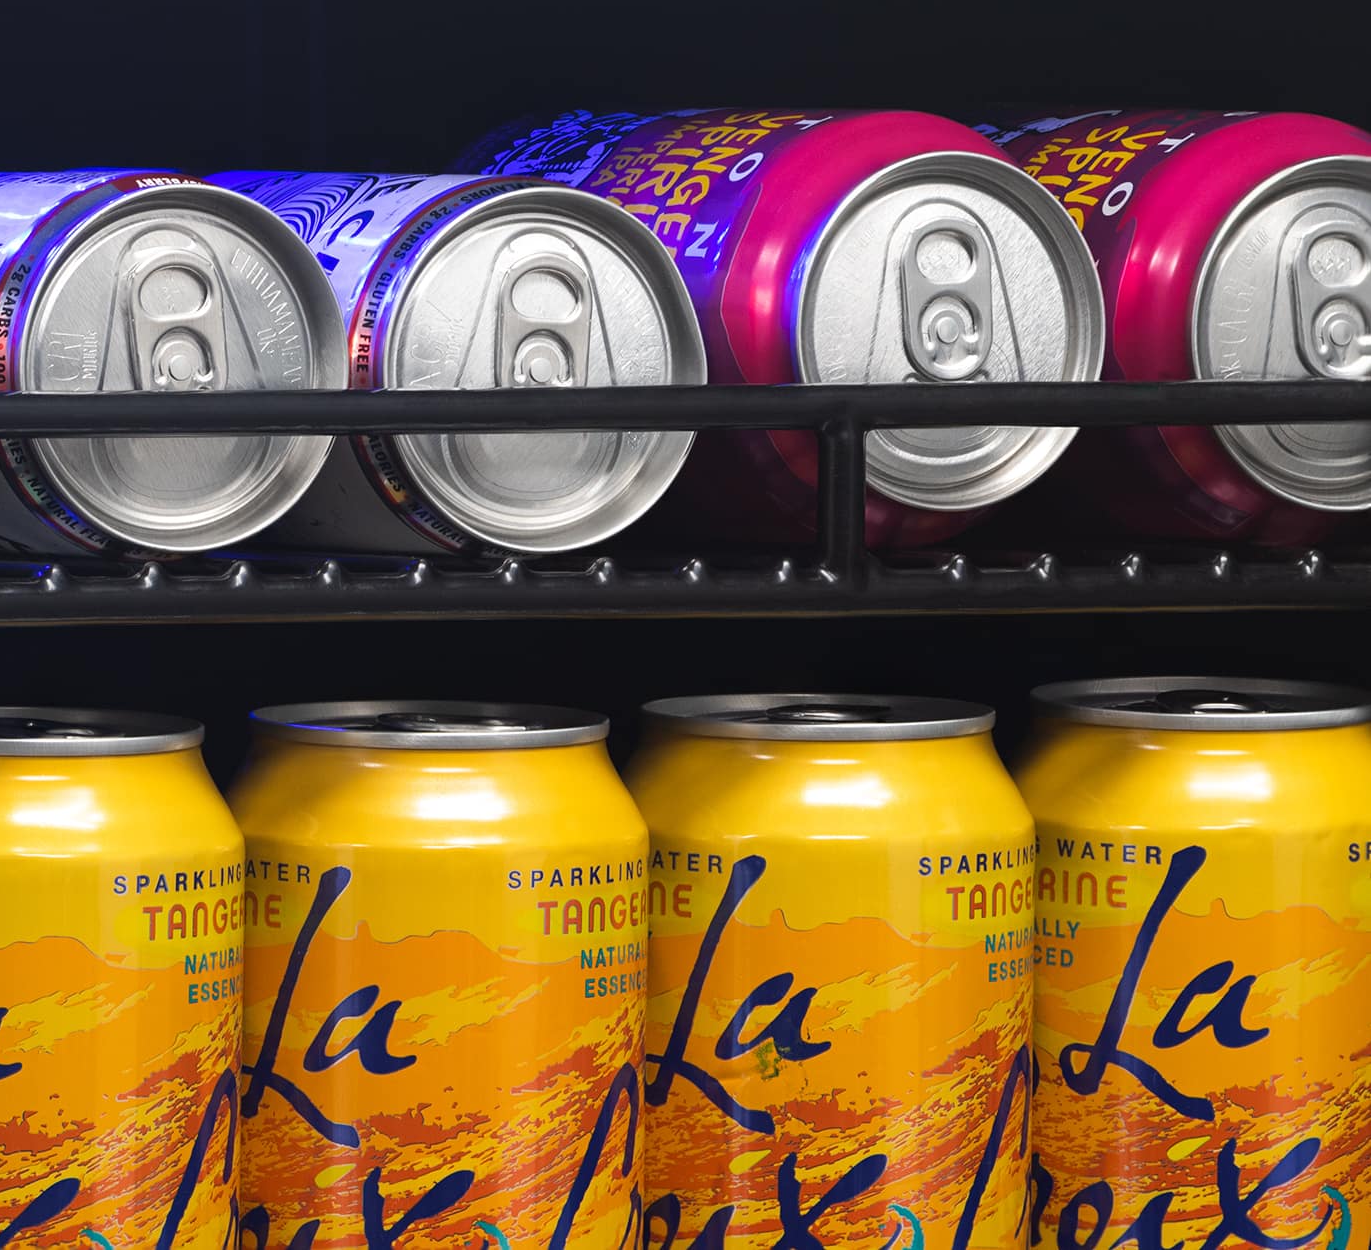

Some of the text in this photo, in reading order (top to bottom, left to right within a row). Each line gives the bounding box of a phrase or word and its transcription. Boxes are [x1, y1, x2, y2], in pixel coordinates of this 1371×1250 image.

[393, 220, 432, 260] CARBS
[361, 272, 393, 330] GLUTEN
[356, 333, 372, 373] FREE
[26, 475, 79, 531] NATURAL
[368, 435, 465, 544] ALORIES NATURAL
[245, 859, 312, 885] ATER
[651, 849, 724, 875] ATER
[1056, 837, 1164, 866] WATER
[112, 863, 243, 896] SPARKLING
[507, 858, 644, 890] SPARKLING
[142, 896, 244, 942] TANGE
[945, 875, 1034, 922] TANGE
[187, 977, 243, 1005] ESSENC
[643, 853, 832, 1135] La
[1058, 844, 1271, 1122] La
[240, 865, 418, 1149] La
